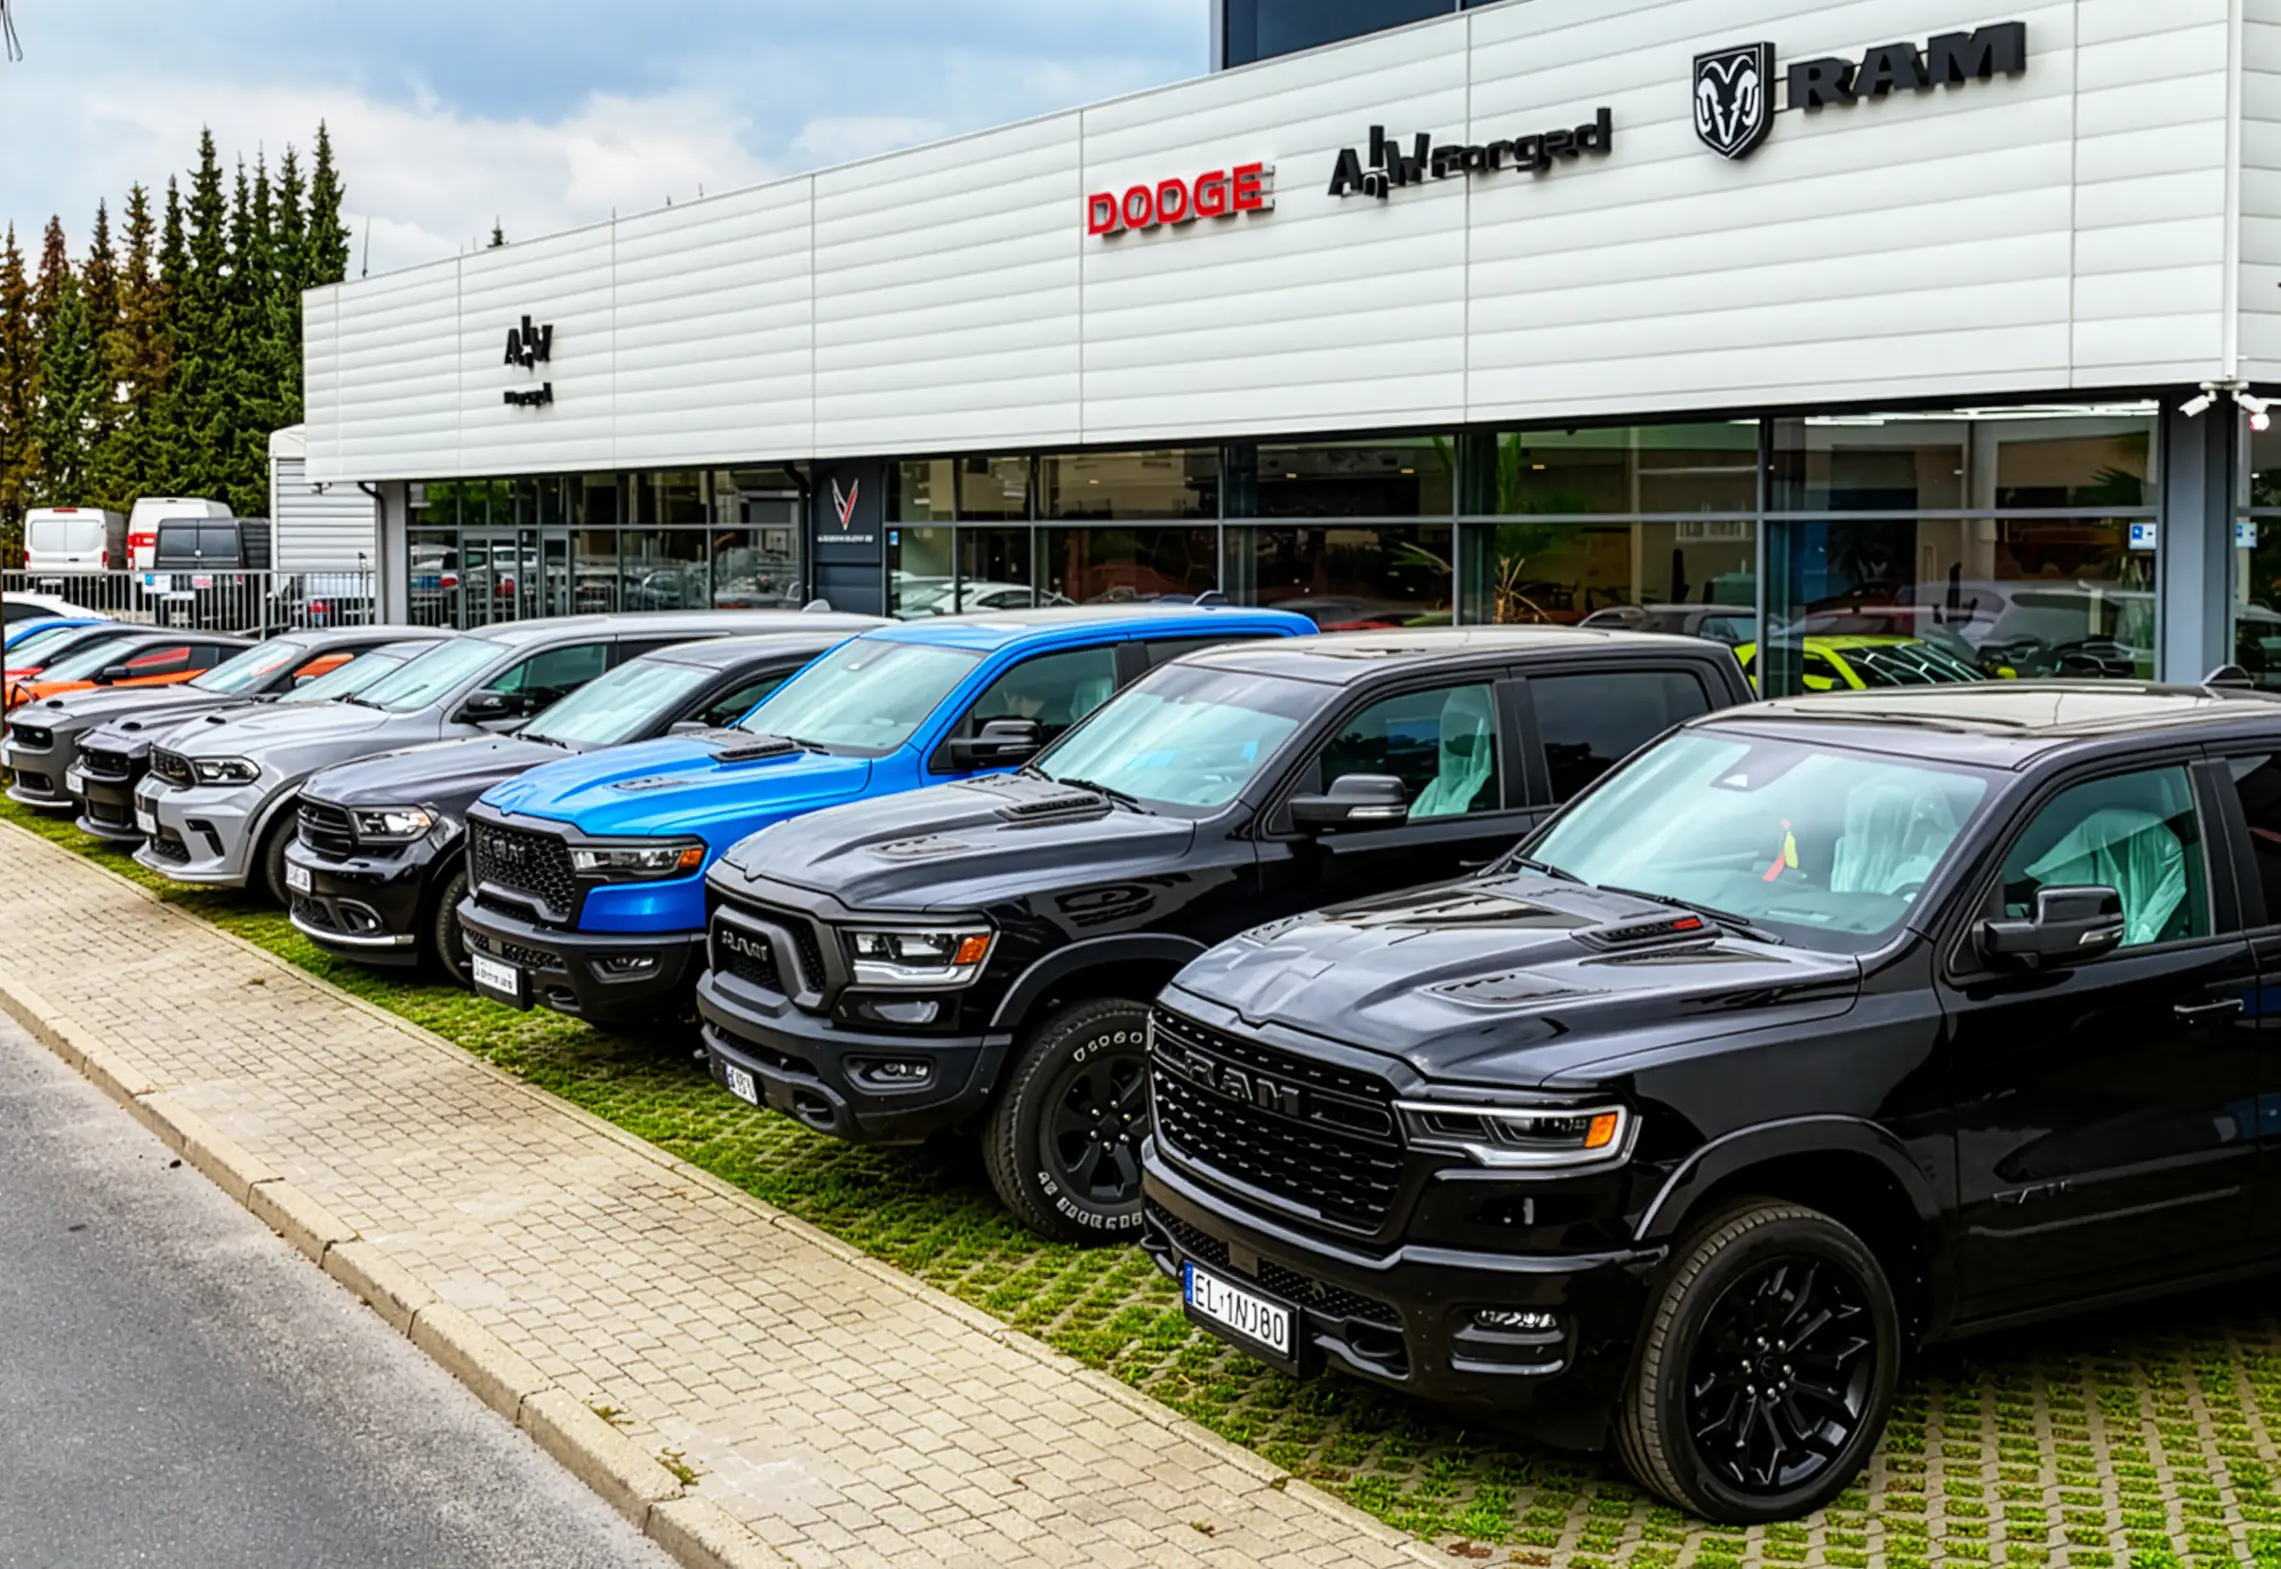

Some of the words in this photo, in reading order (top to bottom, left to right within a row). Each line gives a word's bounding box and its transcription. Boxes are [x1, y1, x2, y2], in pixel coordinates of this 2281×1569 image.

[1788, 21, 2025, 109] RAM
[1088, 162, 1271, 236] DODGE
[1185, 1050, 1300, 1116] RAM
